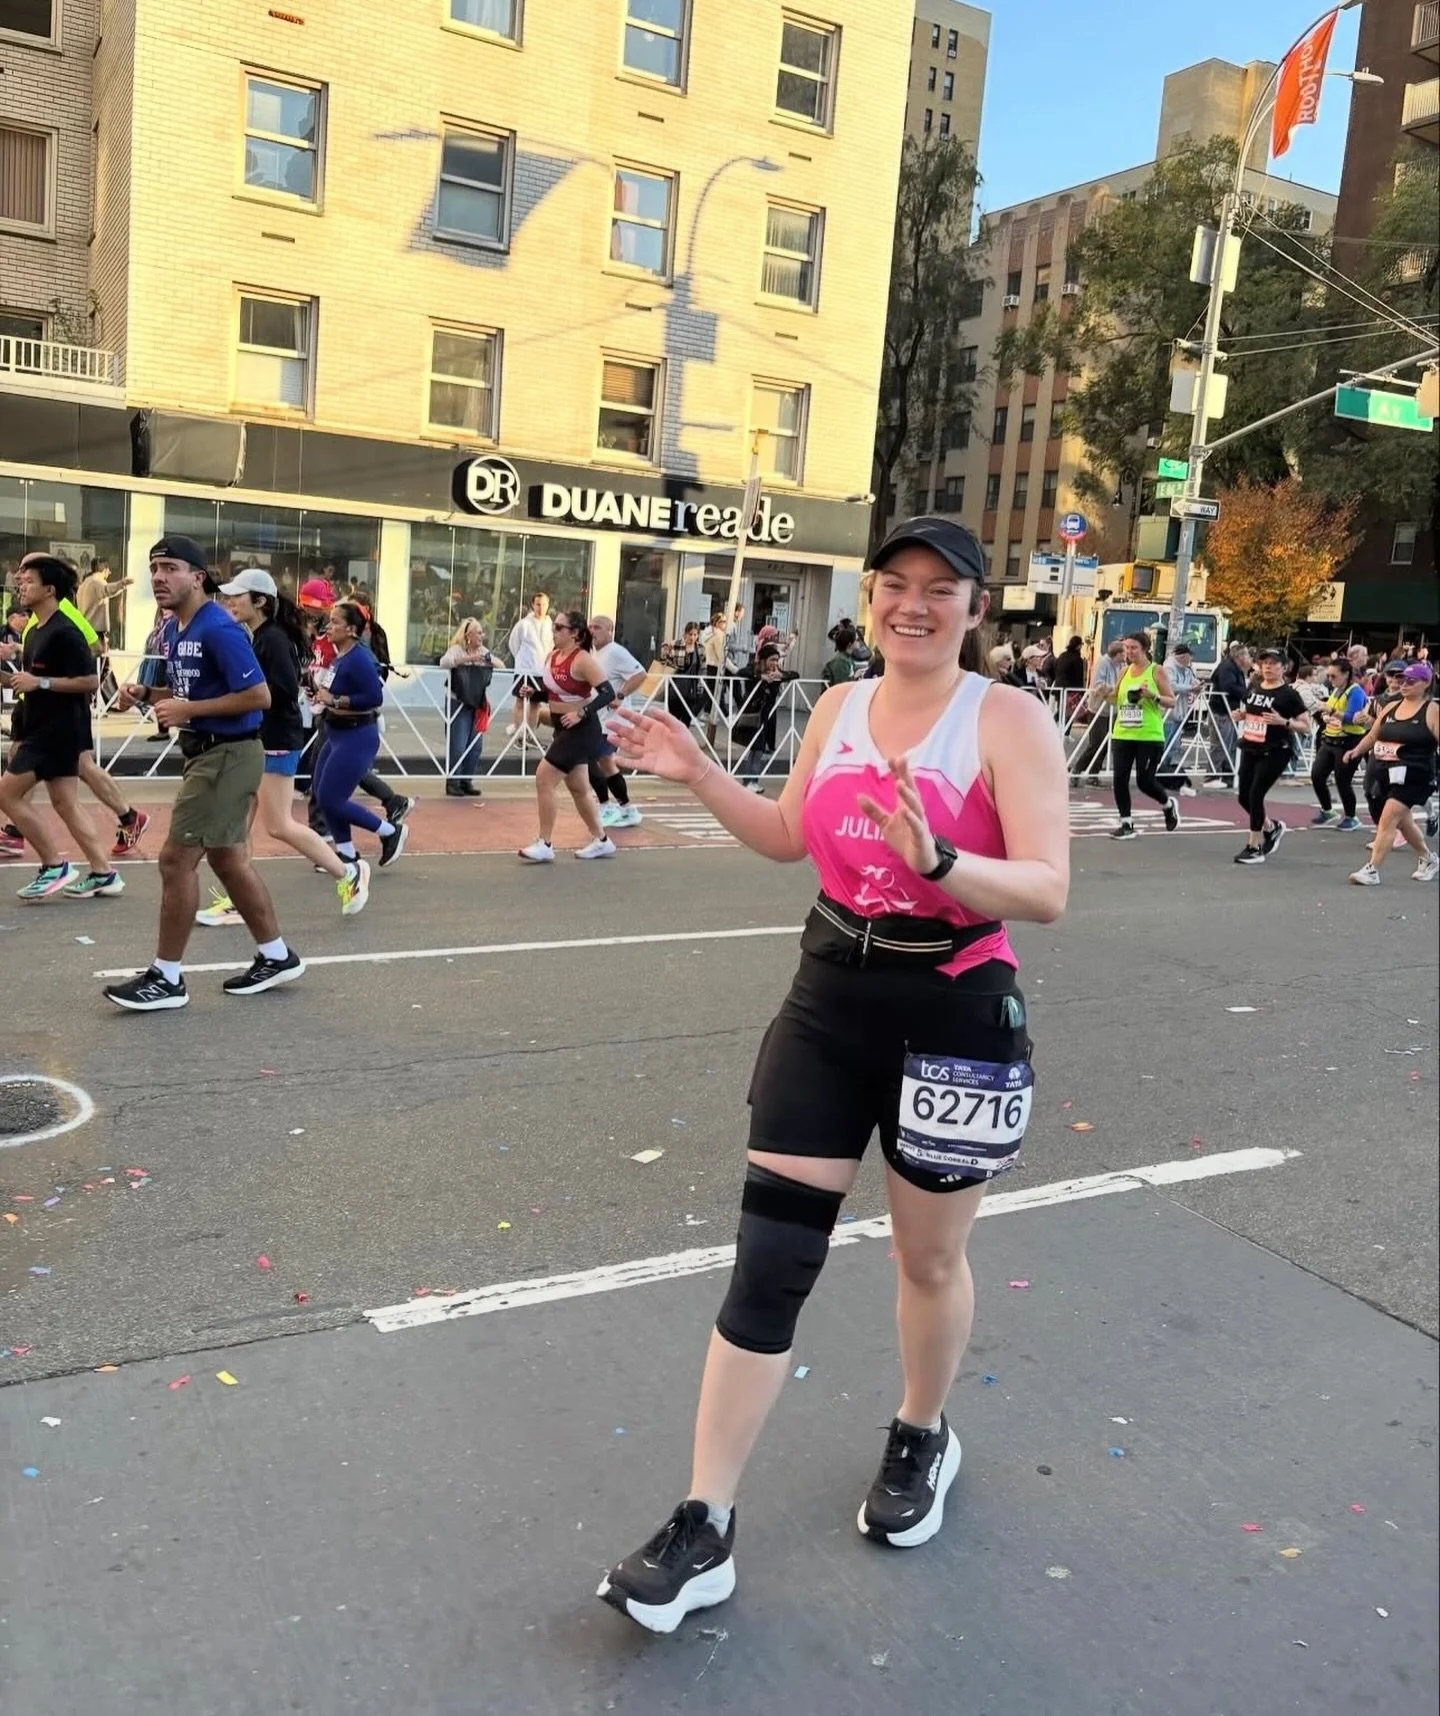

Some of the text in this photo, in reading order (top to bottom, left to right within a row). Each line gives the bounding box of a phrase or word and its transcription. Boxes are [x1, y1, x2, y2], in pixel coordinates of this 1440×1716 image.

[542, 483, 672, 531] DUANE
[1200, 505, 1216, 514] WAY
[1246, 693, 1275, 709] JEN
[835, 816, 884, 841] JULI
[920, 1060, 950, 1081] tcs
[953, 1064, 972, 1073] TATA
[1004, 1080, 1022, 1089] TATA
[912, 1085, 1024, 1129] 62716
[970, 1158, 979, 1166] D
